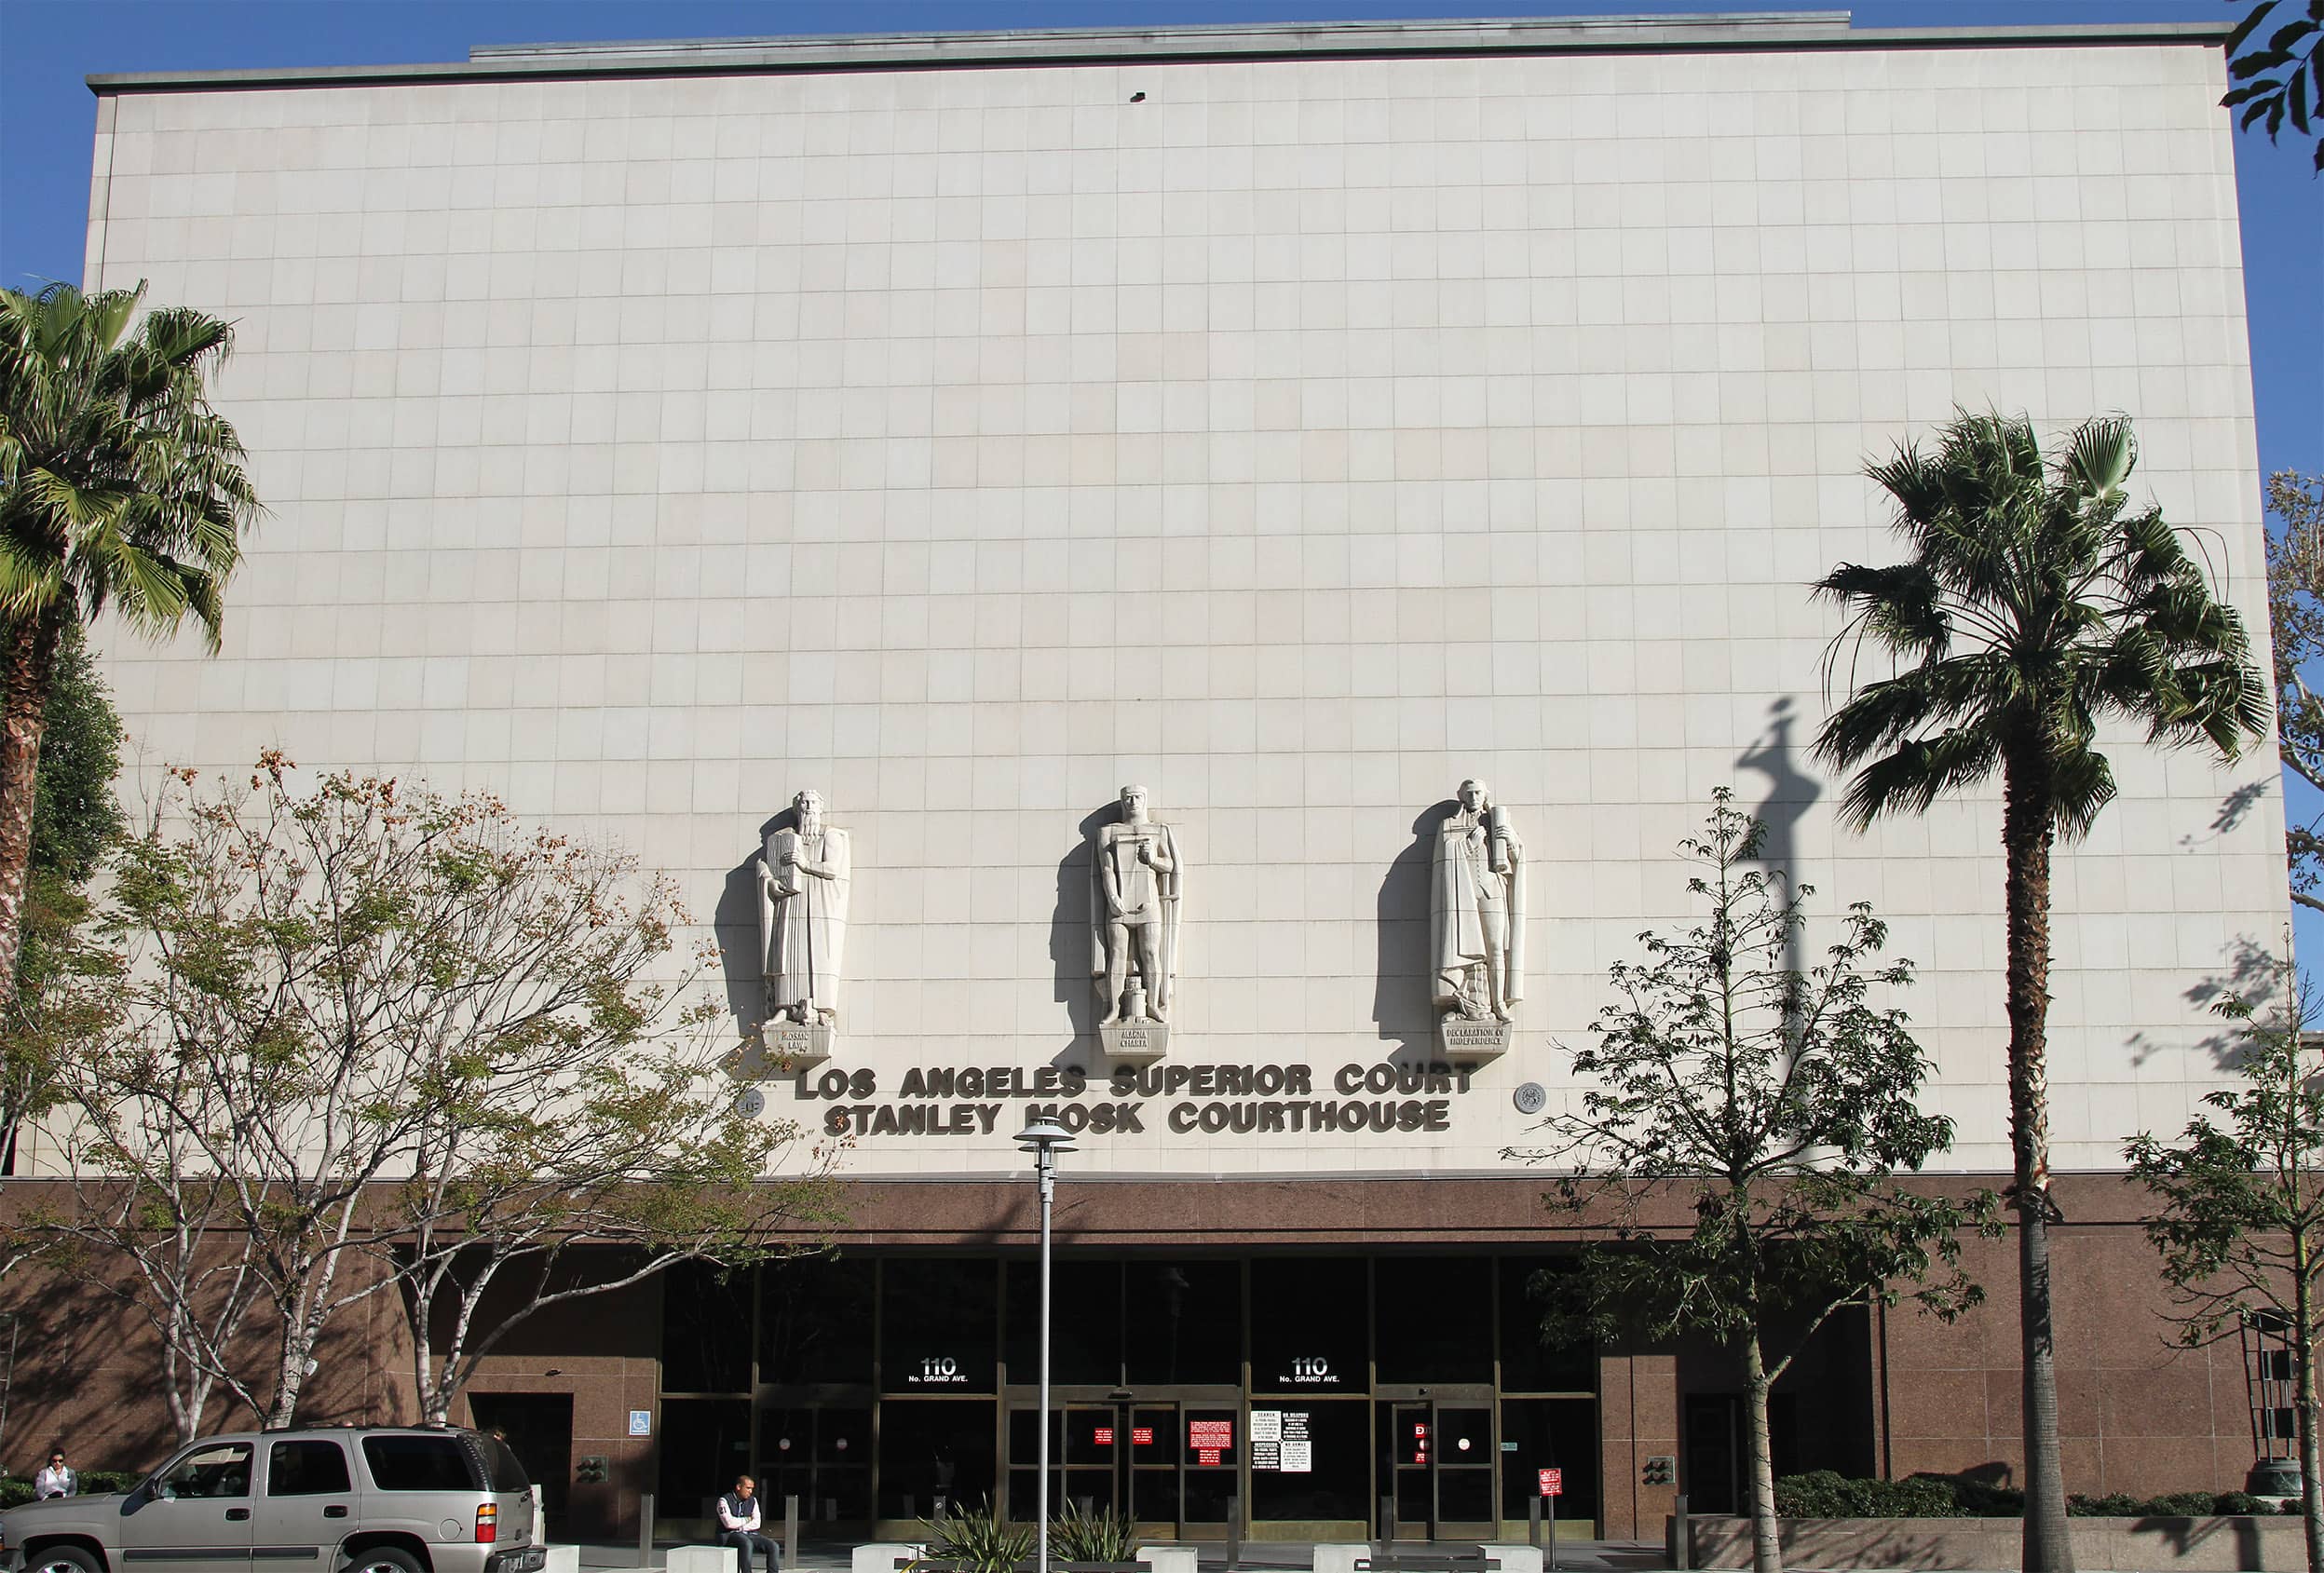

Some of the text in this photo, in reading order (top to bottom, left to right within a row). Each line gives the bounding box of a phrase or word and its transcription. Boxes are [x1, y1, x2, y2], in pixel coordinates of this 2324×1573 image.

[1121, 1029, 1148, 1038] MAGNA
[1447, 1028, 1505, 1037] DECLARATION OF
[788, 1041, 805, 1050] LAW
[1121, 1039, 1148, 1048] CHARTA
[795, 1063, 1478, 1100] LOS ANGELES SUPERIOR COURT
[823, 1100, 1450, 1137] STANLEY MOSK COURTHOUSE
[920, 1357, 957, 1376] 110
[1291, 1357, 1328, 1376] 110
